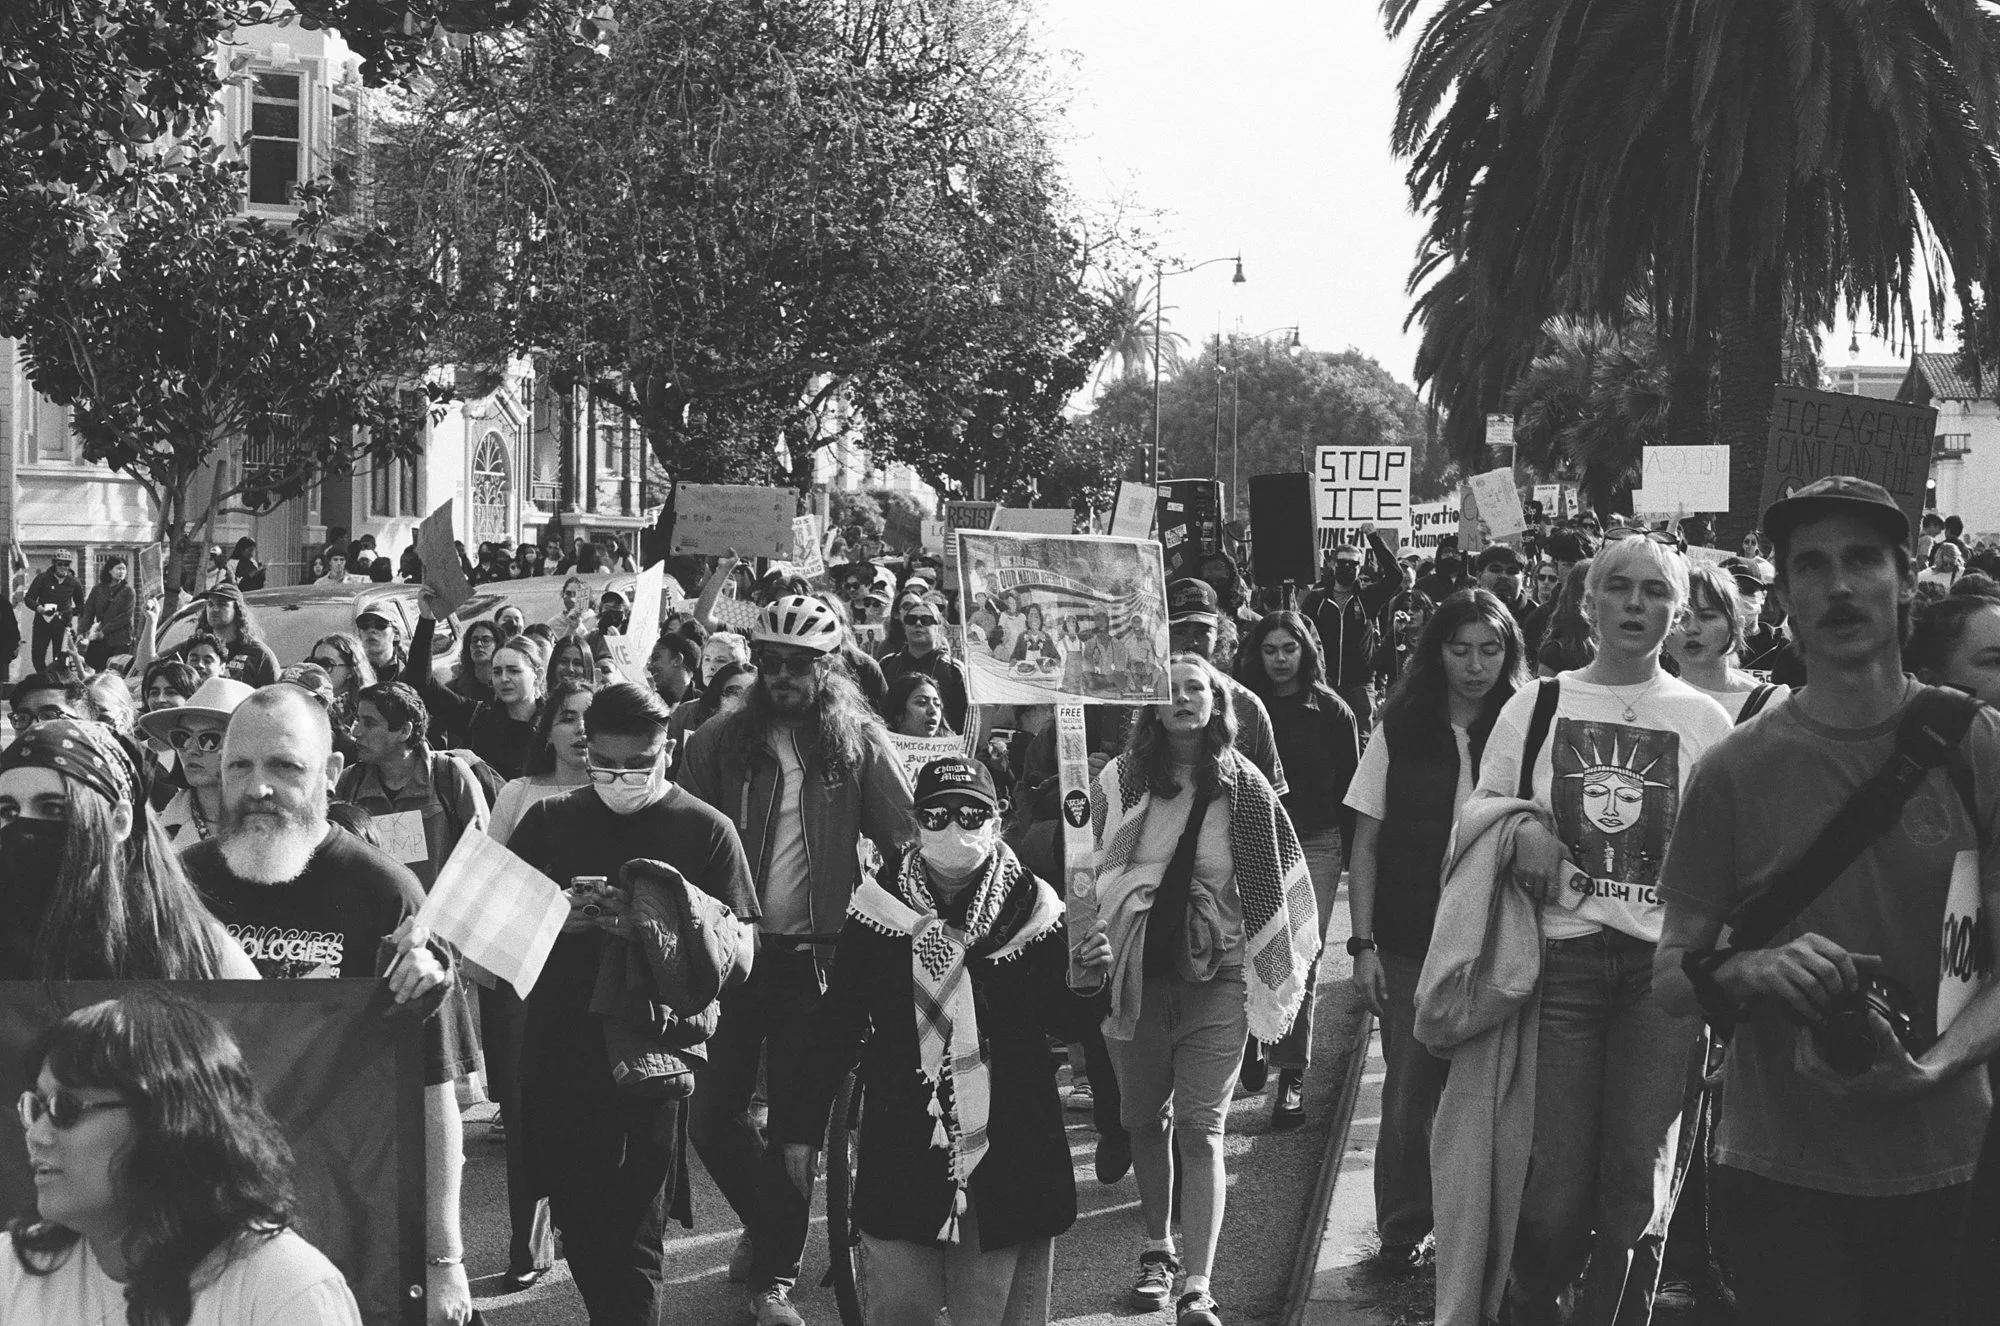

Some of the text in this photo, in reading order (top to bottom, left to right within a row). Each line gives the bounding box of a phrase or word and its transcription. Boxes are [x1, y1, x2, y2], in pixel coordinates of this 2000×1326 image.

[1778, 397, 1936, 457] ICE AGENTS
[1320, 450, 1406, 483] STOP
[1645, 448, 1728, 477] ABOLISH
[1831, 443, 1873, 479] FIND
[1881, 450, 1916, 496] THE
[1322, 487, 1403, 521] ICE
[1000, 569, 1017, 588] OUR
[1018, 569, 1040, 584] NATION
[1060, 707, 1082, 718] FREE
[940, 773, 972, 782] Migra
